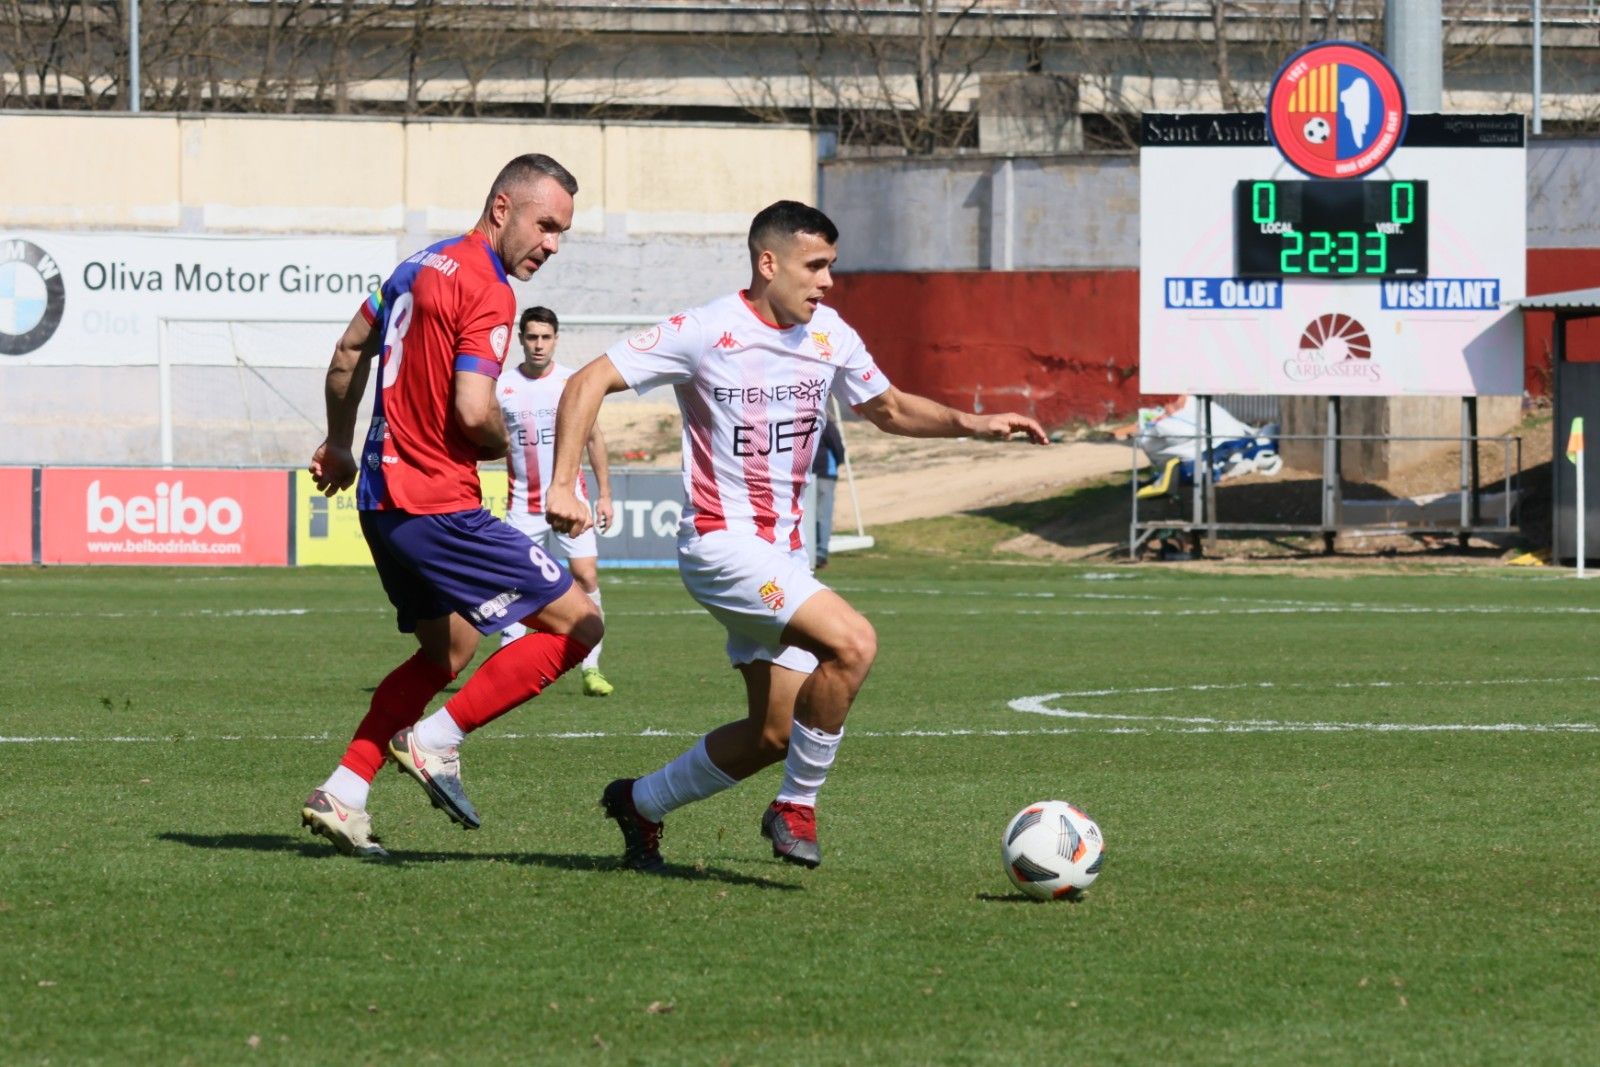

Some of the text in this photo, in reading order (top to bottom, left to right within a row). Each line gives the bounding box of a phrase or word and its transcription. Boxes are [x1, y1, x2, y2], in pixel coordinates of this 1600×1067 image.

[1147, 120, 1200, 141] Sant
[1252, 182, 1276, 224] 0
[1390, 182, 1414, 224] 0
[1260, 221, 1295, 234] LOCAL
[1280, 231, 1387, 274] 22:33
[83, 261, 382, 294] Oliva Motor Girona
[1168, 280, 1279, 308] U.E. OLOT
[1384, 280, 1497, 309] VISITANT
[86, 479, 244, 535] beibo
[86, 538, 242, 554] www.beibodrinks.com
[528, 545, 561, 582] 8
